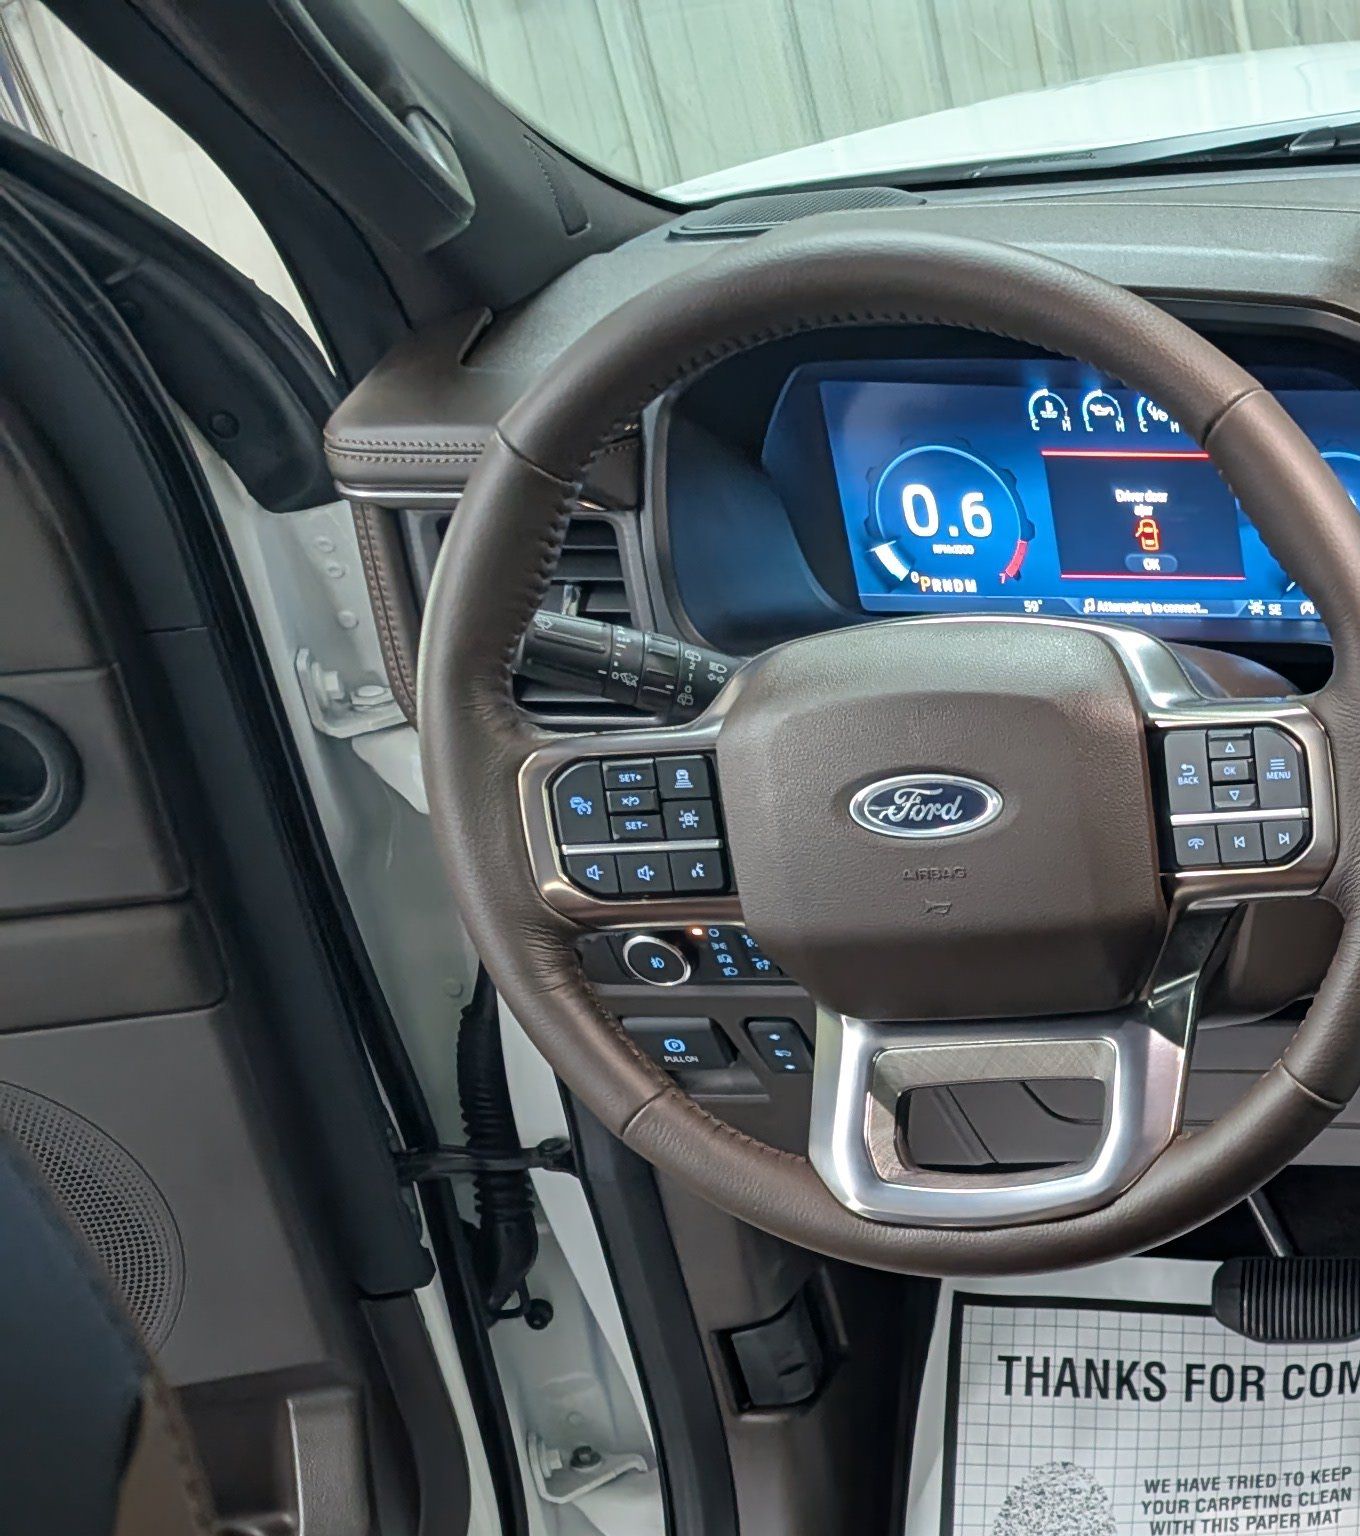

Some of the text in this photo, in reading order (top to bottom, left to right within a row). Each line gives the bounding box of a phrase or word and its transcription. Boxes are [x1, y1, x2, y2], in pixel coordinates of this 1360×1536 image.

[1115, 488, 1168, 503] Driver door
[902, 483, 993, 538] 0.6
[1143, 558, 1160, 571] OK
[1097, 600, 1152, 615] Attempting
[1223, 766, 1237, 776] OK
[1266, 770, 1292, 781] MENU
[1177, 775, 1199, 786] BACK
[868, 787, 963, 822] Ford
[903, 866, 967, 881] AIRBAG
[664, 1055, 699, 1063] PULL ON
[997, 1355, 1168, 1402] THANKS
[1184, 1362, 1266, 1404] FOR
[1144, 1466, 1352, 1494] WE HAVE TRIED TO KEEP
[1141, 1487, 1352, 1515] YOUR CARPETING CLEAN
[1150, 1508, 1342, 1536] WITH THIS PAPER MAT
